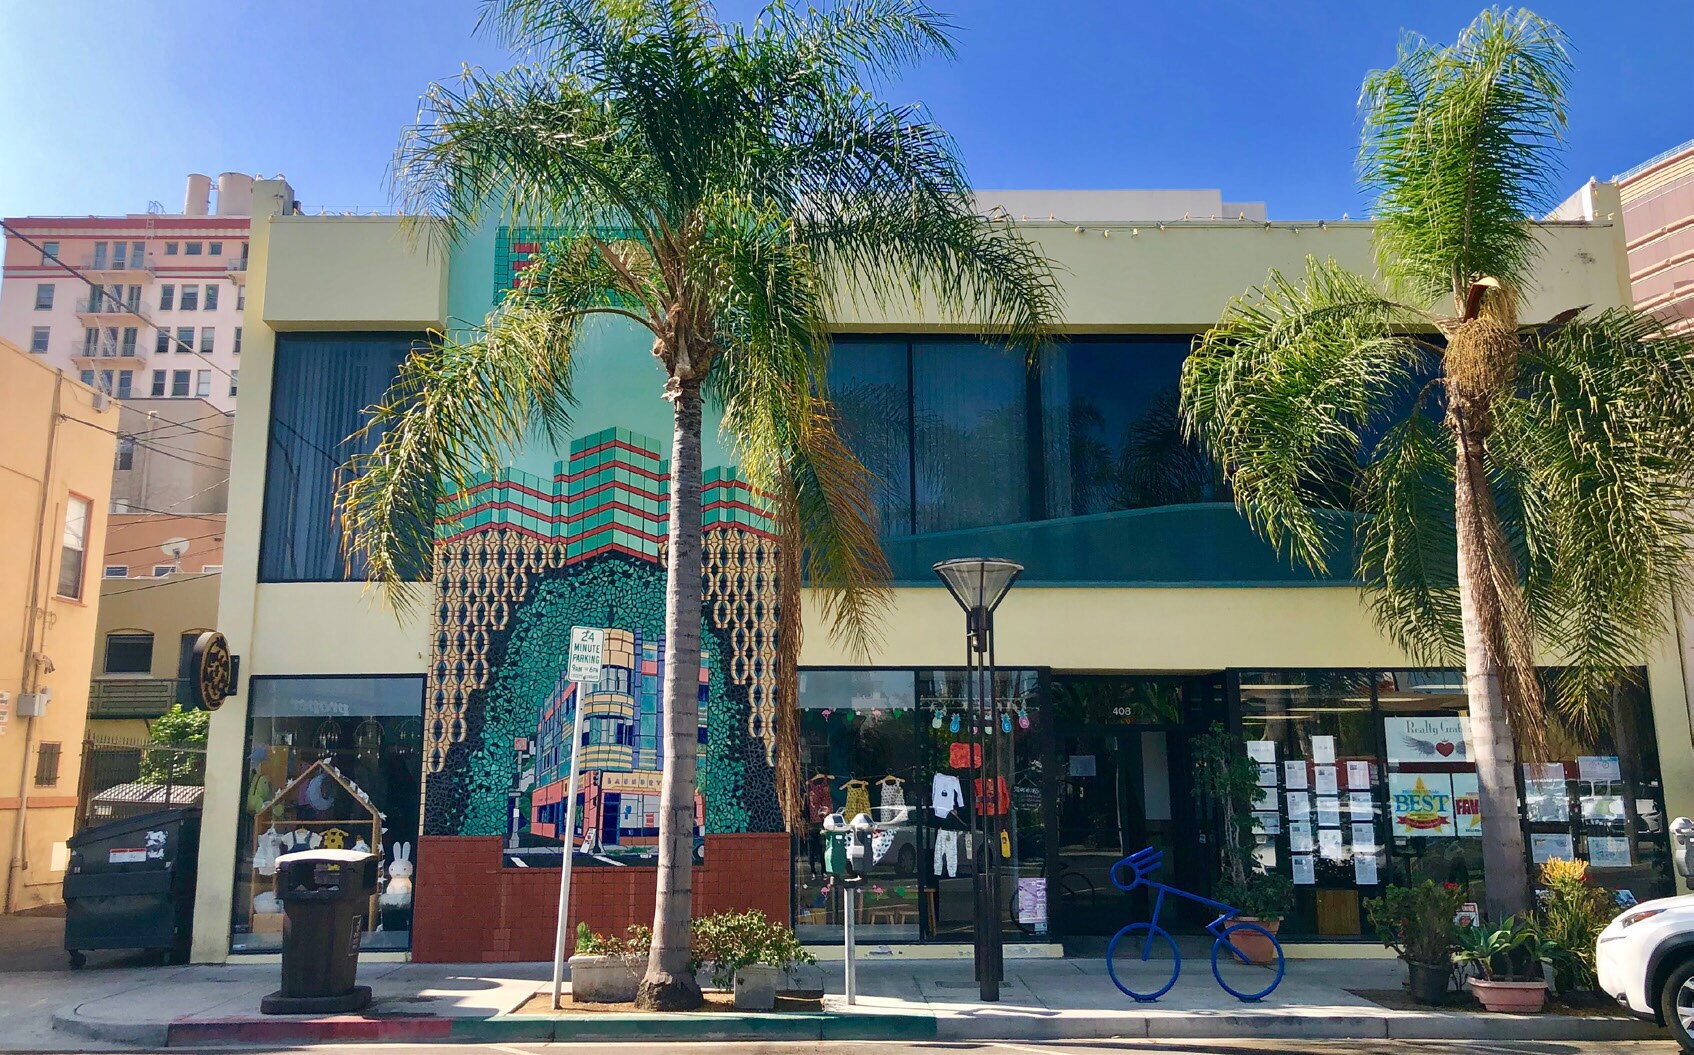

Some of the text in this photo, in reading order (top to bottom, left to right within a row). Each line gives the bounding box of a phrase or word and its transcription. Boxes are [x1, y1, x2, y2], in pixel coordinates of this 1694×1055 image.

[581, 631, 595, 642] 24
[573, 643, 601, 653] MINUTE
[572, 654, 600, 664] PARKING
[1112, 706, 1132, 716] 408
[1393, 794, 1450, 812] BEST
[1455, 799, 1479, 815] FAV
